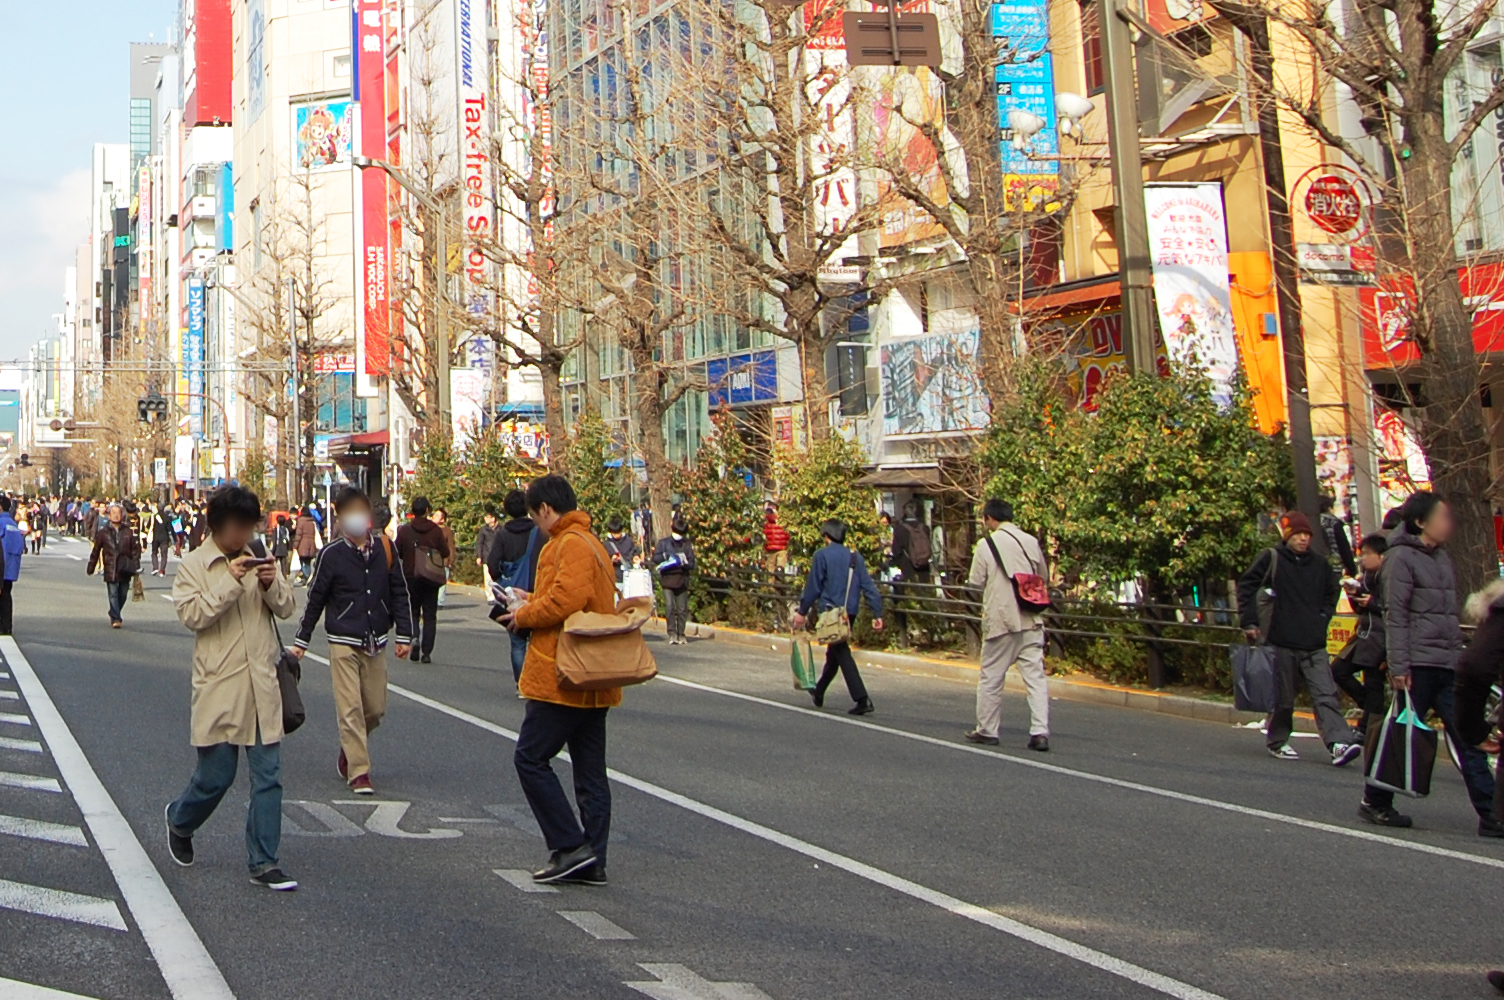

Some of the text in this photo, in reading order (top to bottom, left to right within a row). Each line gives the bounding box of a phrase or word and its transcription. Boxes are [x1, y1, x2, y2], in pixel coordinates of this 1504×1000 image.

[464, 92, 488, 209] Tax-free
[1309, 191, 1359, 217] 消火栓
[1160, 237, 1218, 252] 安全 安心
[1157, 252, 1224, 267] 元気なアキバ
[1304, 251, 1346, 262] docomo
[375, 245, 386, 301] SAKAGUCHI
